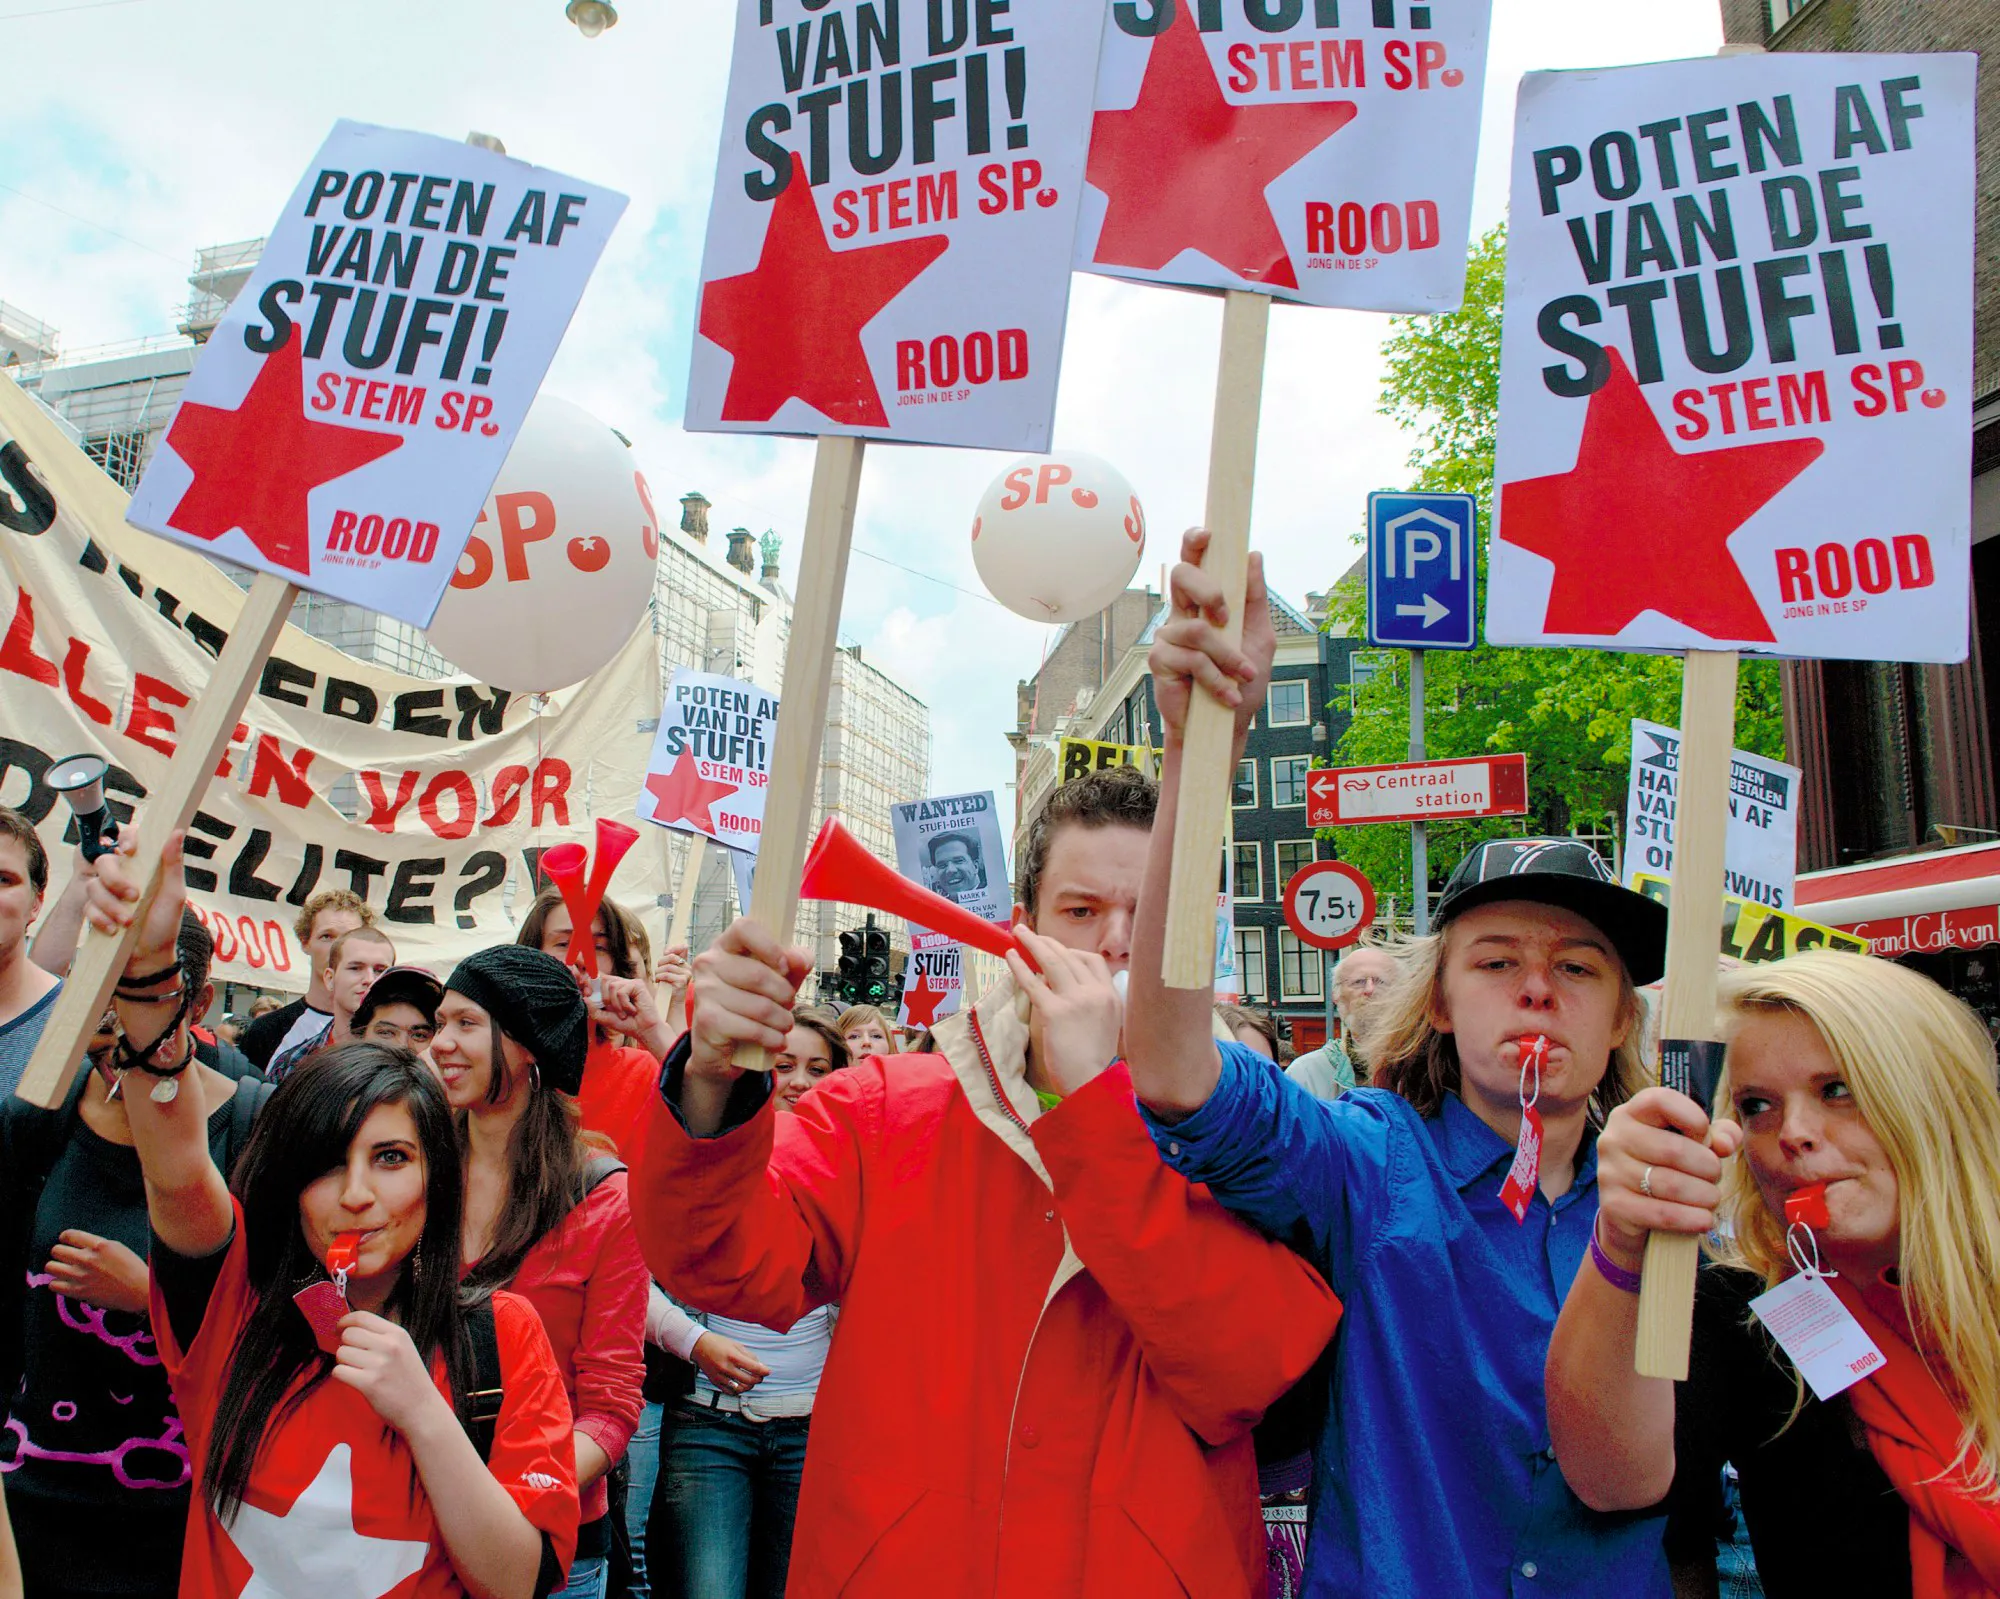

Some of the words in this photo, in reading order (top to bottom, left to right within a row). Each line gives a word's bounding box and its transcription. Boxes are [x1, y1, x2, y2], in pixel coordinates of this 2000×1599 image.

[776, 2, 901, 94] VAN
[928, 0, 1014, 56] DE
[1228, 39, 1366, 94] STEM
[744, 46, 1029, 202] STUFI!
[1532, 94, 1803, 216] POTEN
[1834, 75, 1925, 160] AF
[304, 169, 496, 237] POTEN
[504, 189, 588, 247] AF
[832, 170, 959, 239] STEM
[1305, 199, 1440, 256] ROOD
[1566, 188, 1738, 285] VAN
[1760, 166, 1873, 251] DE
[306, 224, 424, 290] VAN
[434, 240, 518, 302] DE
[1306, 257, 1332, 270] JONG
[1335, 258, 1345, 270] IN
[1348, 258, 1361, 270] DE
[1364, 258, 1379, 269] SP
[244, 279, 510, 387] STUFI!
[1537, 243, 1904, 398] STUFI!
[896, 328, 1029, 392] ROOD
[310, 372, 427, 426] STEM
[897, 394, 924, 406] JONG
[927, 393, 938, 404] IN
[941, 391, 953, 402] DE
[957, 389, 971, 401] SP
[1672, 370, 1832, 441] STEM
[325, 509, 440, 564] ROOD
[1405, 530, 1442, 579] P
[1774, 534, 1936, 604] ROOD
[1783, 605, 1814, 619] JONG
[1818, 603, 1830, 616] IN
[1834, 601, 1848, 614] DE
[1852, 600, 1868, 612] SP
[675, 685, 750, 715] POTEN
[683, 704, 728, 733] VAN
[735, 715, 763, 740] DE
[666, 725, 766, 771] STUFI!
[700, 761, 744, 783] STEM
[748, 771, 769, 789] SP
[1376, 769, 1455, 790] Centraal
[1730, 777, 1783, 807] BETALEN
[899, 794, 988, 823] WANTED
[1415, 790, 1484, 808] station
[1745, 804, 1773, 829] AF
[719, 811, 761, 834] ROOD
[918, 817, 976, 833] STUFI-DIEF!
[960, 891, 980, 901] MARK
[920, 933, 949, 948] ROOD
[1911, 912, 1956, 949] Café
[1959, 923, 1994, 943] van
[914, 952, 960, 977] STUFI!
[929, 977, 950, 990] STEM
[1850, 1352, 1879, 1374] ROOD
